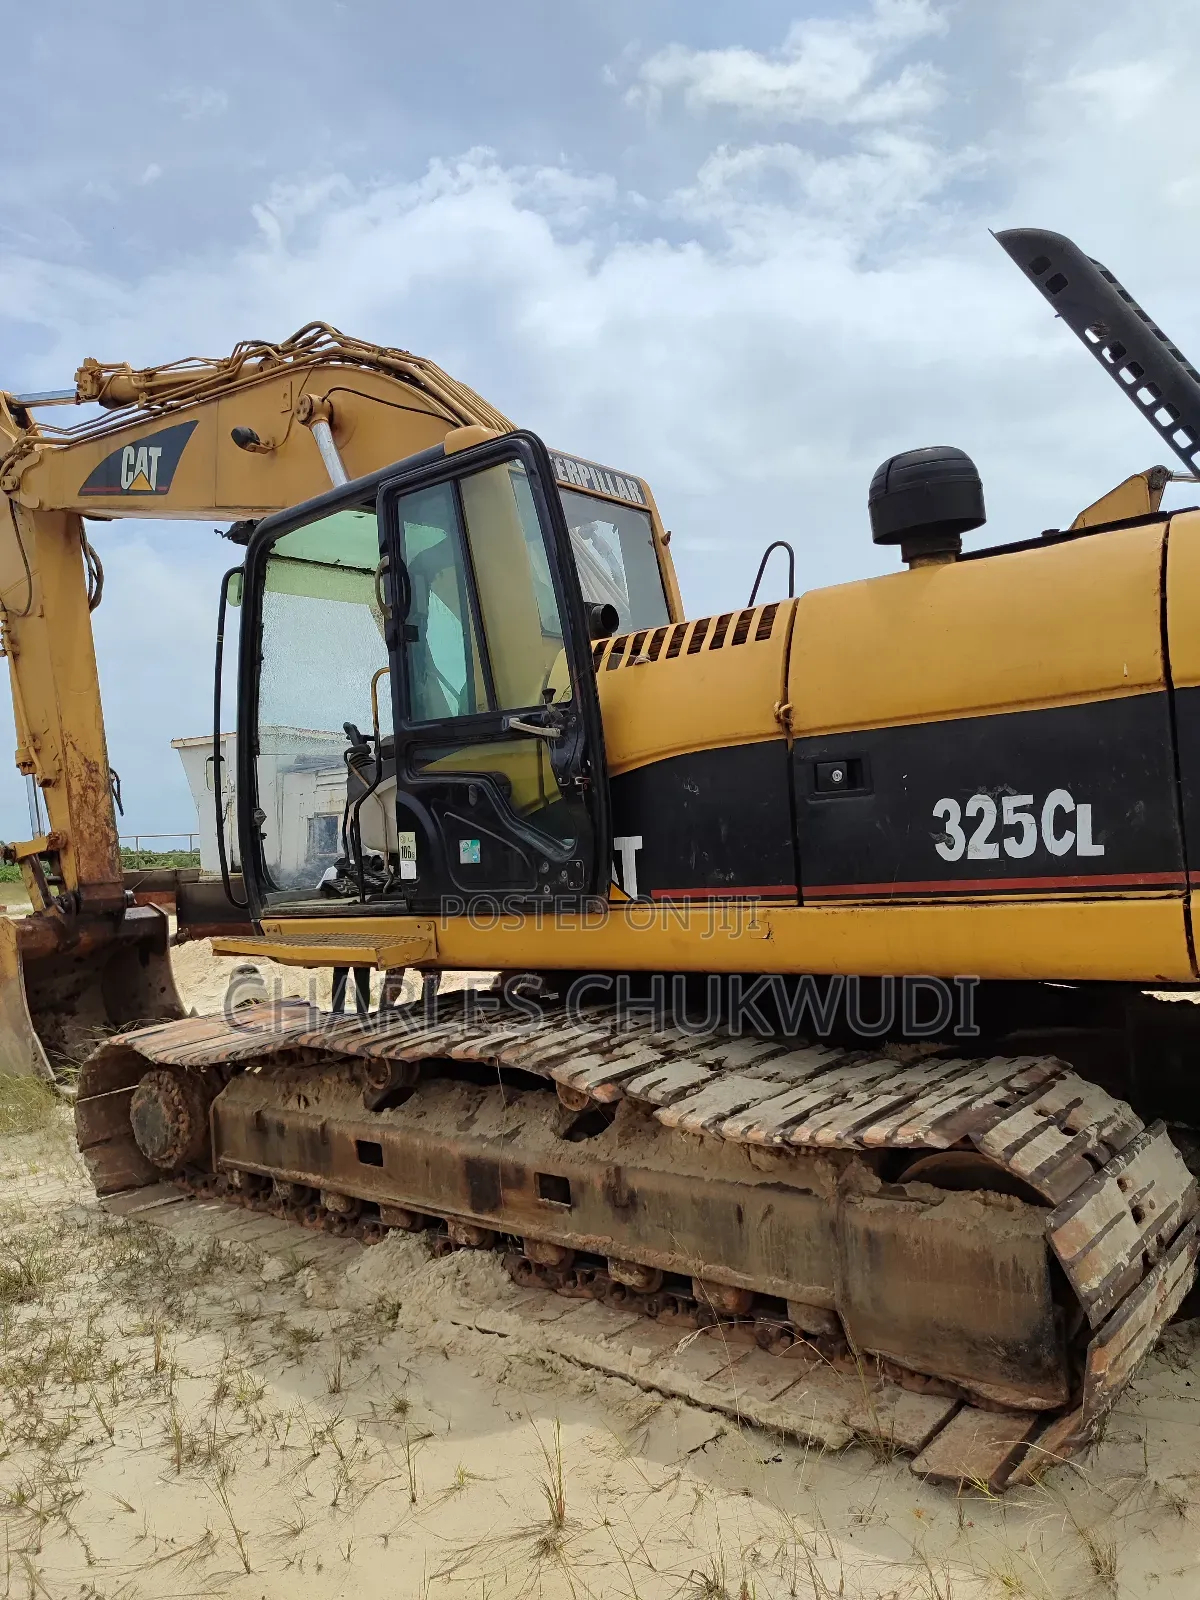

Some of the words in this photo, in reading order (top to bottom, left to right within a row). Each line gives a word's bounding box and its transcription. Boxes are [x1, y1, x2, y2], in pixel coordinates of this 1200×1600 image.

[121, 445, 162, 491] CAT
[549, 454, 643, 504] ERPILLAR
[932, 788, 1105, 862] 325CL
